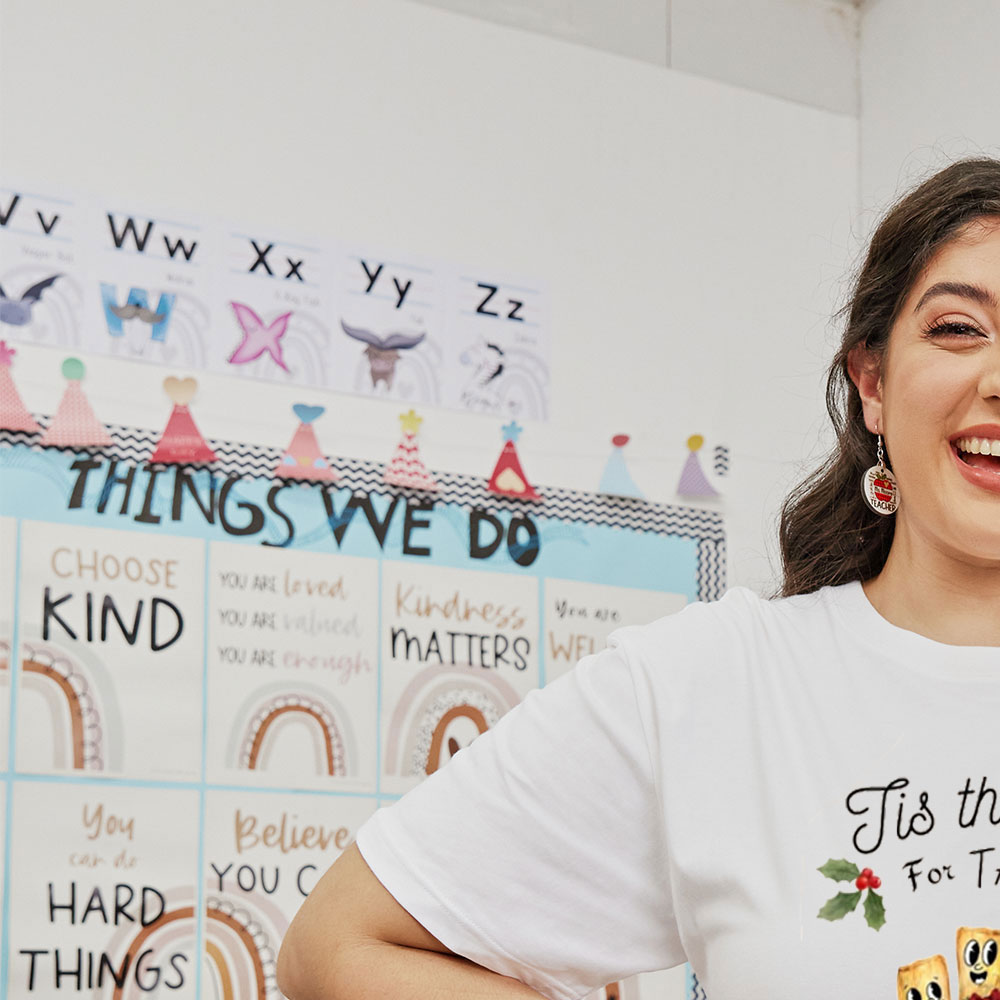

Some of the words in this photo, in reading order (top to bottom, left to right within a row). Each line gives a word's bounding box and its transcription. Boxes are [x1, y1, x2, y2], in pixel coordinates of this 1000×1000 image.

[67, 458, 298, 548] THINGS
[321, 488, 433, 557] WE
[468, 508, 540, 567] DO
[51, 547, 178, 590] CHOOSE
[218, 572, 246, 592] YOU
[252, 574, 277, 594] ARE
[284, 569, 347, 600] loved
[42, 586, 185, 652] KIND
[218, 609, 246, 628] YOU
[252, 611, 277, 631] ARE
[283, 612, 362, 638] valued
[395, 583, 528, 630] Kindness
[217, 646, 246, 665] YOU
[251, 648, 276, 668] ARE
[282, 650, 372, 685] enough
[83, 803, 136, 842] You
[234, 809, 355, 855] Believe
[69, 853, 106, 869] can
[210, 862, 280, 896] YOU
[902, 858, 956, 892] For
[47, 881, 167, 928] HARD
[20, 946, 190, 992] THINGS
